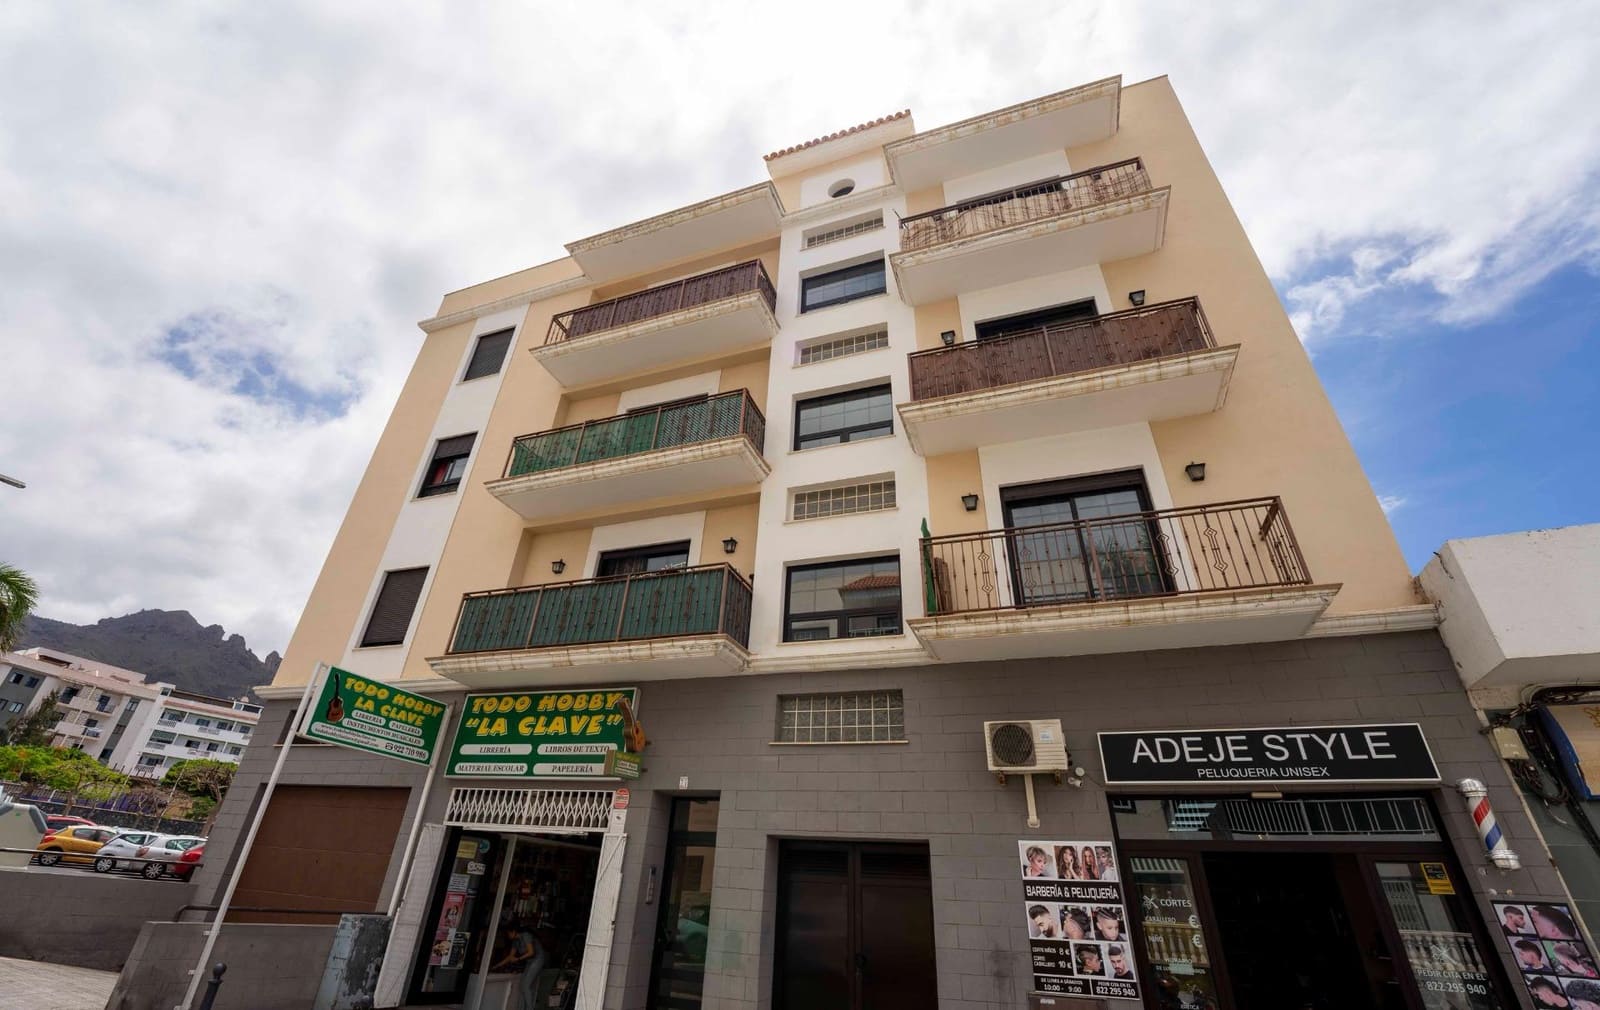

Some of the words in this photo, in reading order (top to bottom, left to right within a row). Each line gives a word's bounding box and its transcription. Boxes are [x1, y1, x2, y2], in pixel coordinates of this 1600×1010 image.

[345, 677, 389, 700] TODO
[392, 693, 443, 717] HOBBY
[472, 695, 531, 714] TODO
[537, 692, 624, 712] HOBBY
[354, 696, 375, 712] LA
[380, 704, 425, 726] CLAVE
[346, 719, 390, 737] INSTRUMENTOS
[391, 732, 421, 745] MUSICALES
[393, 744, 404, 754] 922
[479, 744, 511, 754] LIBRERÍA
[544, 744, 573, 754] LIBROS
[573, 745, 582, 753] DE
[582, 744, 610, 753] TEXTO
[1132, 736, 1253, 764] ADEJE
[1263, 731, 1396, 761] STYLE
[457, 764, 495, 773] MATERIAL
[495, 763, 525, 773] ESCOLAR
[552, 763, 593, 773] PAPELERÍA
[1197, 767, 1278, 778] PELUQUERIA
[1281, 766, 1330, 777] UNISEX
[1025, 884, 1063, 897] BARBERÍA
[1064, 886, 1070, 898] &
[1071, 886, 1119, 900] PELUQUERÍA
[1160, 898, 1192, 908] CORTES
[1188, 914, 1200, 928] €
[1192, 934, 1203, 948] €
[1058, 961, 1066, 969] 10
[1417, 969, 1442, 977] PEDIR
[1443, 971, 1462, 980] CITA
[1462, 972, 1474, 980] EN
[1476, 973, 1487, 981] EL
[1096, 986, 1109, 995] 822
[1110, 987, 1122, 996] 295
[1122, 988, 1136, 996] 940
[1426, 981, 1445, 991] 822
[1448, 982, 1466, 993] 295
[1466, 984, 1487, 995] 940
